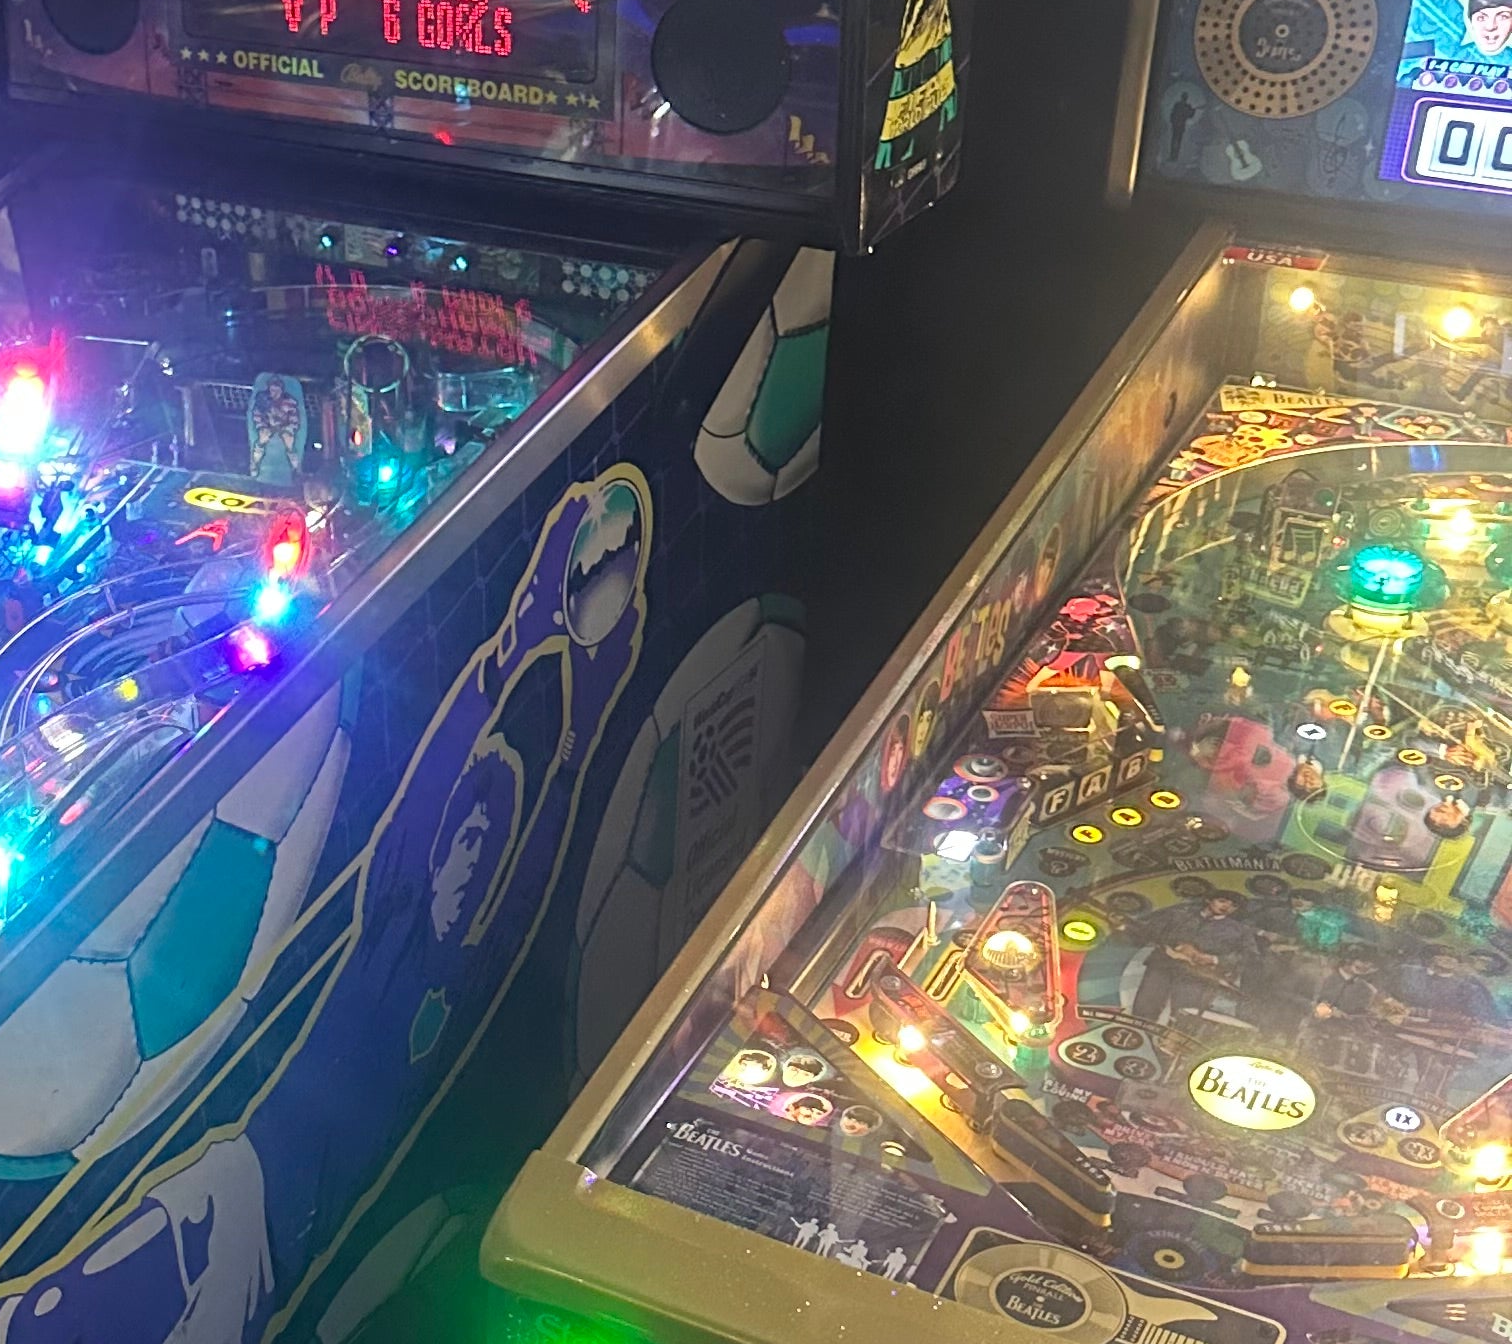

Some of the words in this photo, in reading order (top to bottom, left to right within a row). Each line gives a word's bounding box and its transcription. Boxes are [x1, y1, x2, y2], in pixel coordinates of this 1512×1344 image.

[233, 50, 325, 80] OFFICIAL
[394, 68, 545, 107] SCOREBOARD
[1247, 252, 1293, 267] USA
[1273, 393, 1344, 407] BEATLES
[1049, 791, 1065, 814] F
[1087, 773, 1103, 797] A
[1127, 759, 1143, 779] B
[1195, 1065, 1308, 1119] BEATLES
[1394, 1112, 1414, 1126] 1X
[672, 1123, 743, 1158] BEATLES
[1009, 1270, 1043, 1288] Gold
[1042, 1277, 1086, 1304] Edition
[1022, 1281, 1066, 1302] PINBALL
[1004, 1293, 1062, 1327] BEATLES
